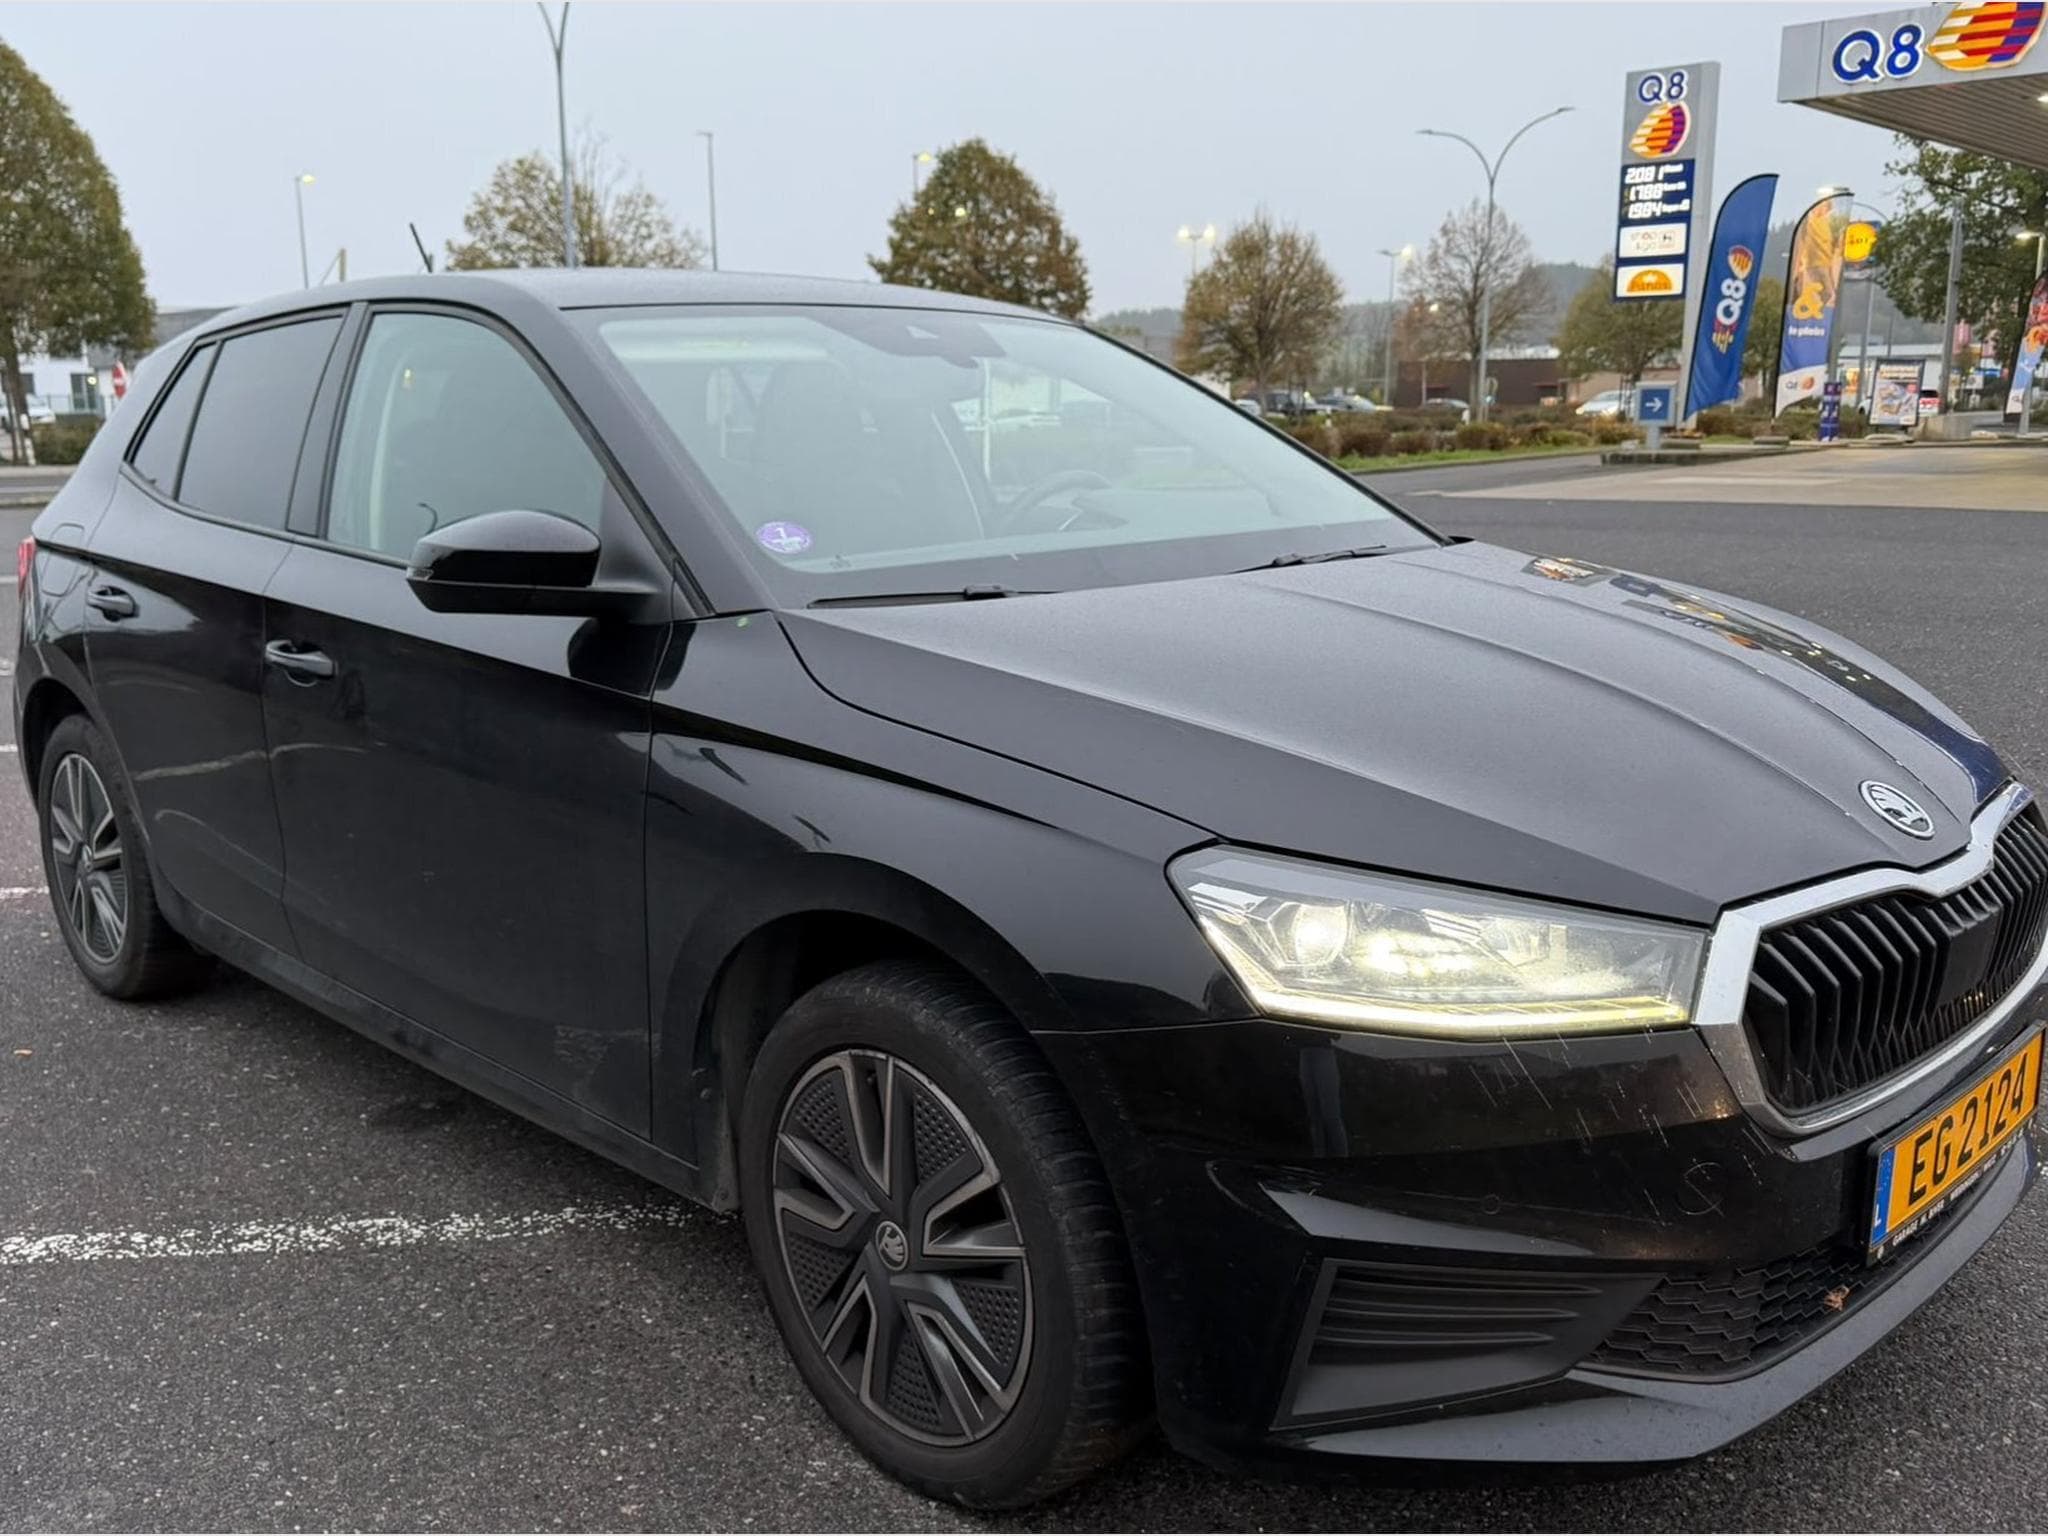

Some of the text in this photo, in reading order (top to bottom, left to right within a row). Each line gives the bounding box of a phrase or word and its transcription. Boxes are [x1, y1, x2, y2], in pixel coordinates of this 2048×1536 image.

[1832, 23, 1923, 83] Q8
[1638, 70, 1687, 103] Q8
[1716, 277, 1746, 325] Q8
